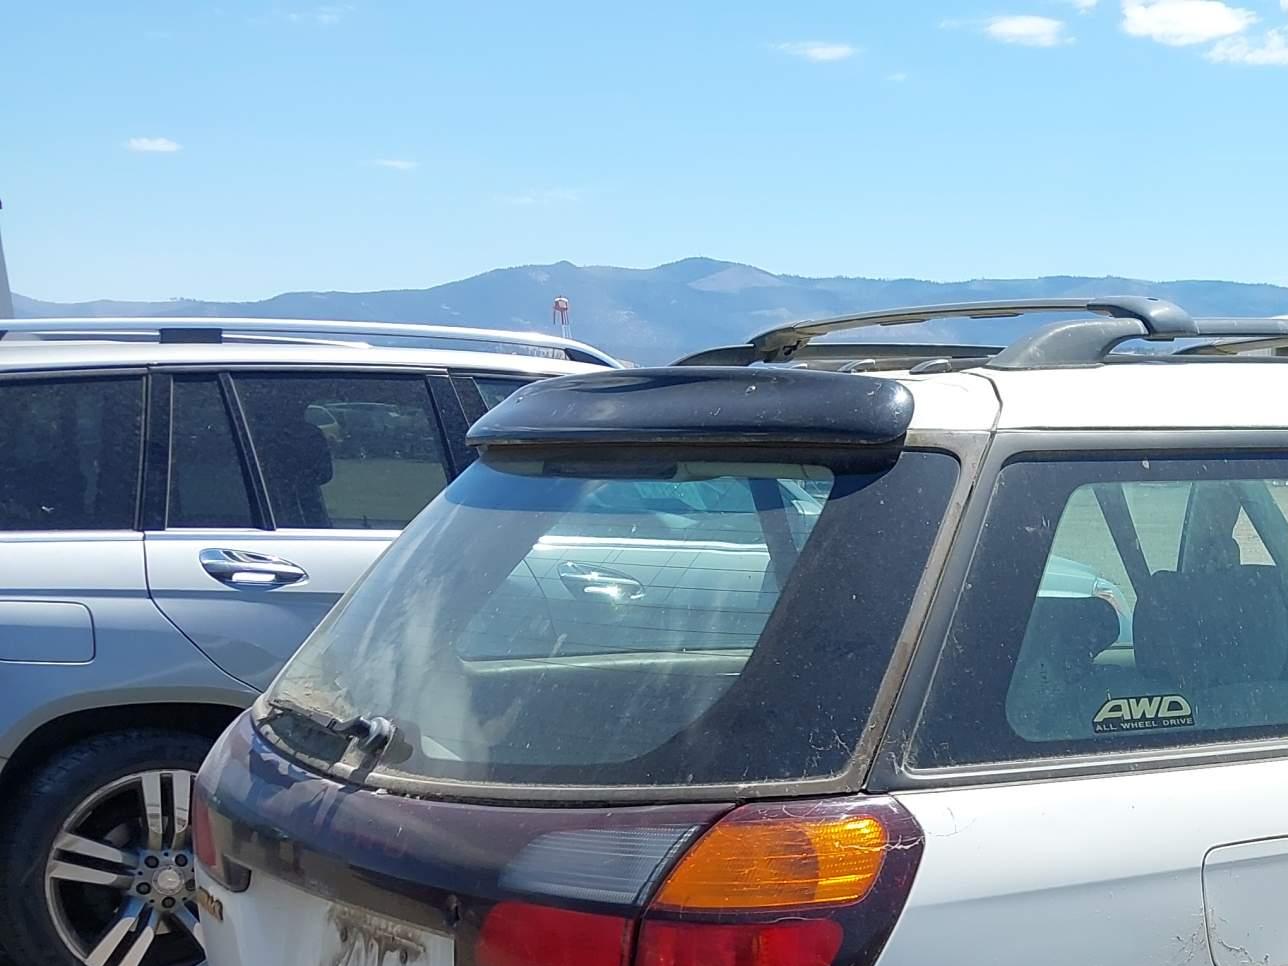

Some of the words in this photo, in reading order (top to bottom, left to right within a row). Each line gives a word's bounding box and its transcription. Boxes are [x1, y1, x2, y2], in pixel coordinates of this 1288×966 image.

[1094, 695, 1192, 722] AWD
[1095, 723, 1117, 732] ALL
[1120, 720, 1158, 729] WHEEL
[1163, 718, 1193, 726] DRIVE
